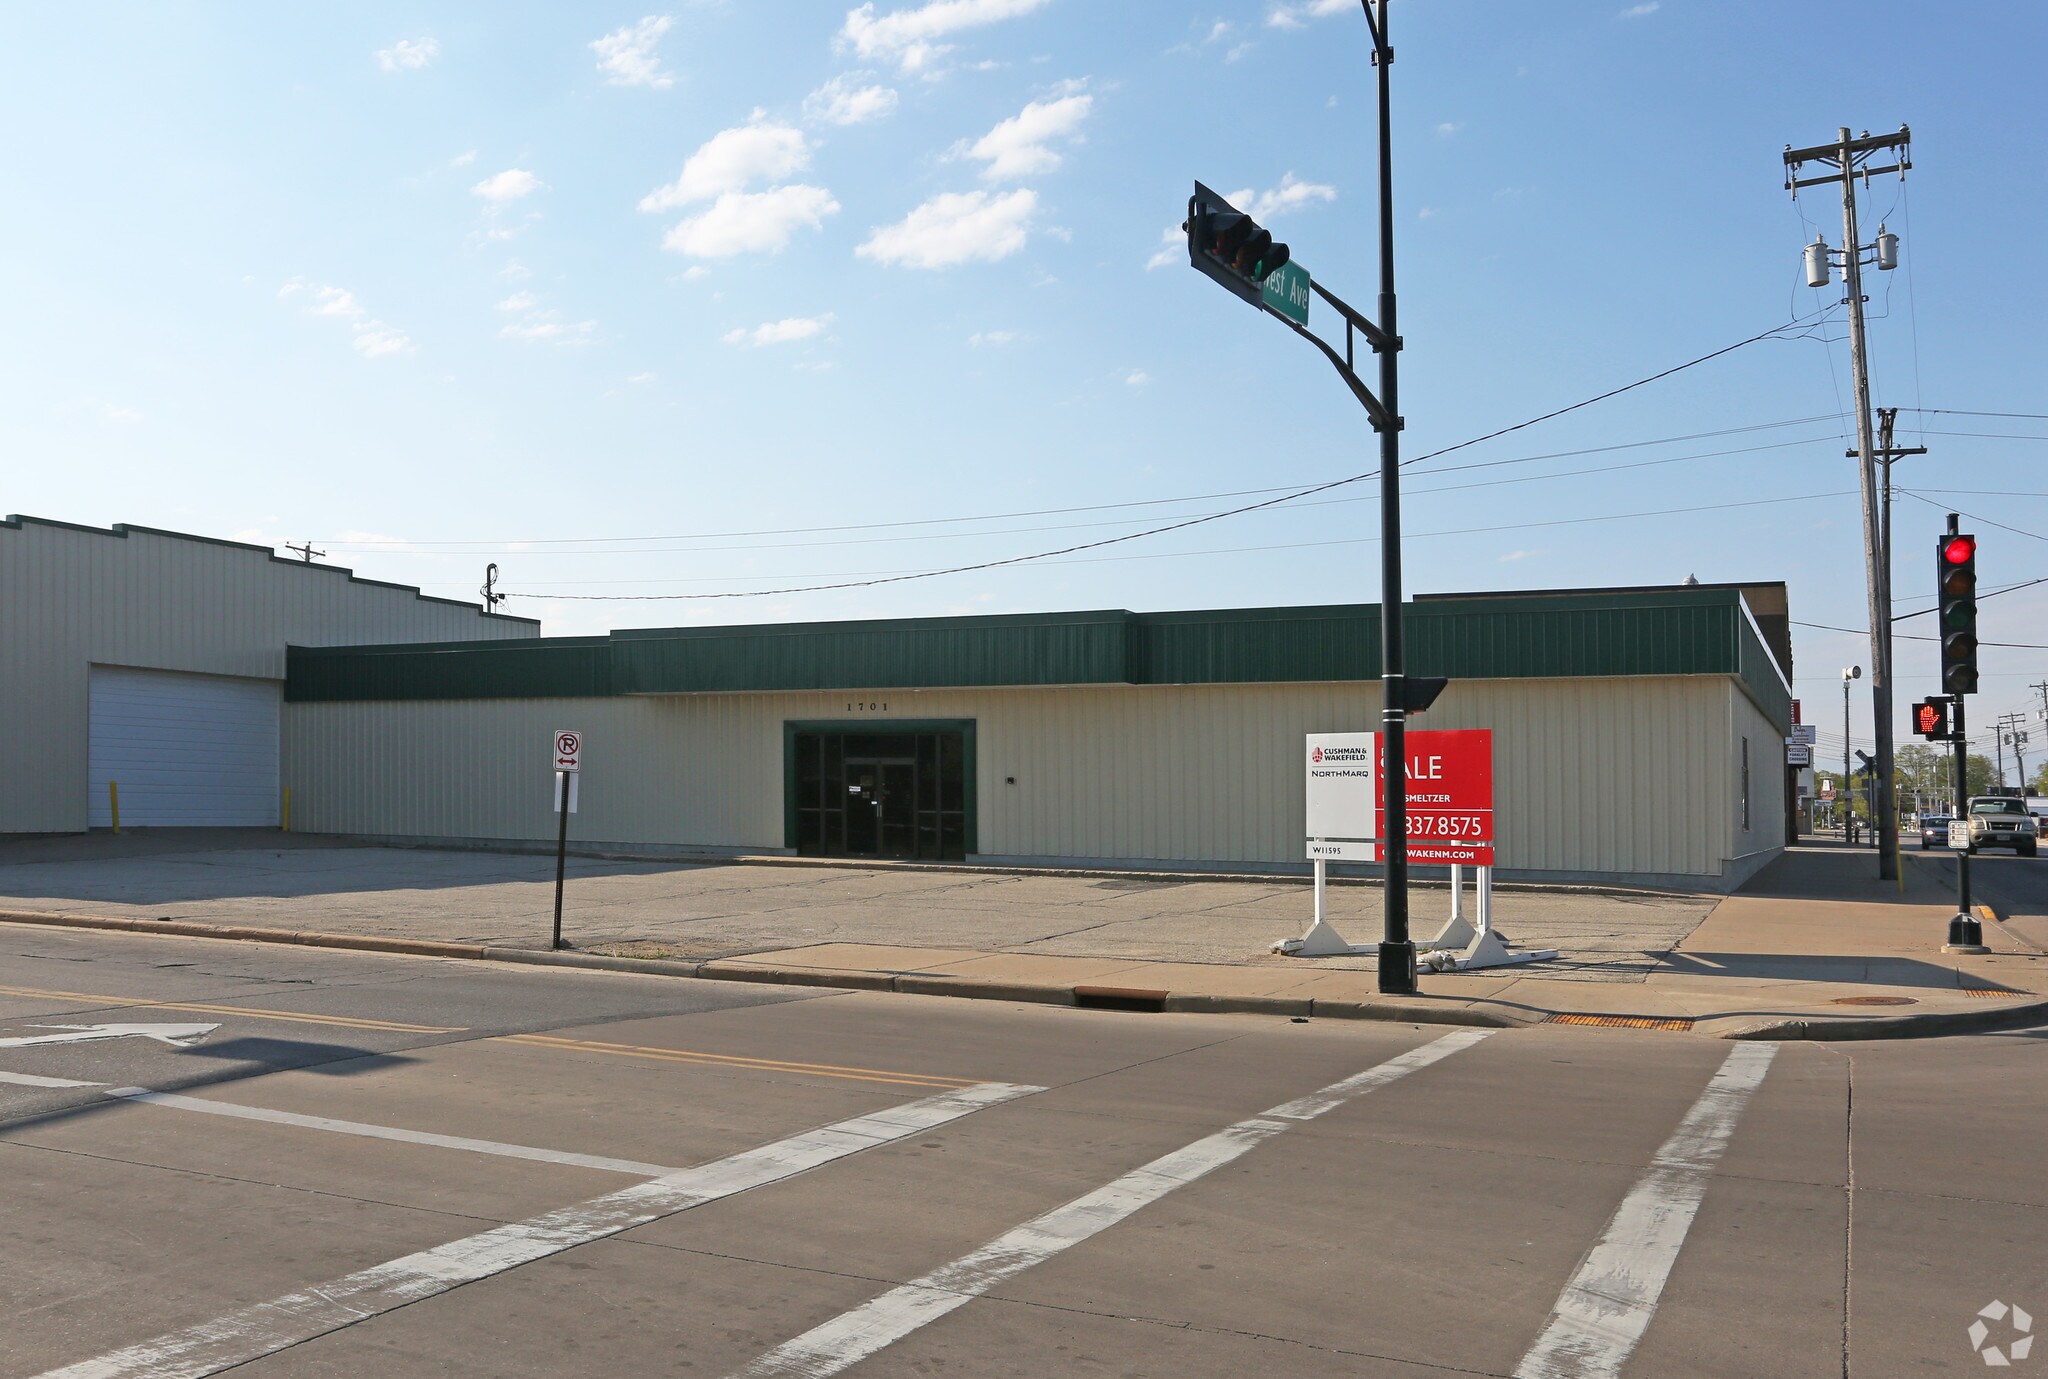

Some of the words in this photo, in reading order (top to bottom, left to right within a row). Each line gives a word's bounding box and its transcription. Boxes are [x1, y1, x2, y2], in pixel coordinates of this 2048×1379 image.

[1289, 276, 1308, 310] Ave
[847, 702, 888, 711] 1701
[1381, 755, 1442, 780] LE
[1382, 849, 1475, 859] WAKENM.COM
